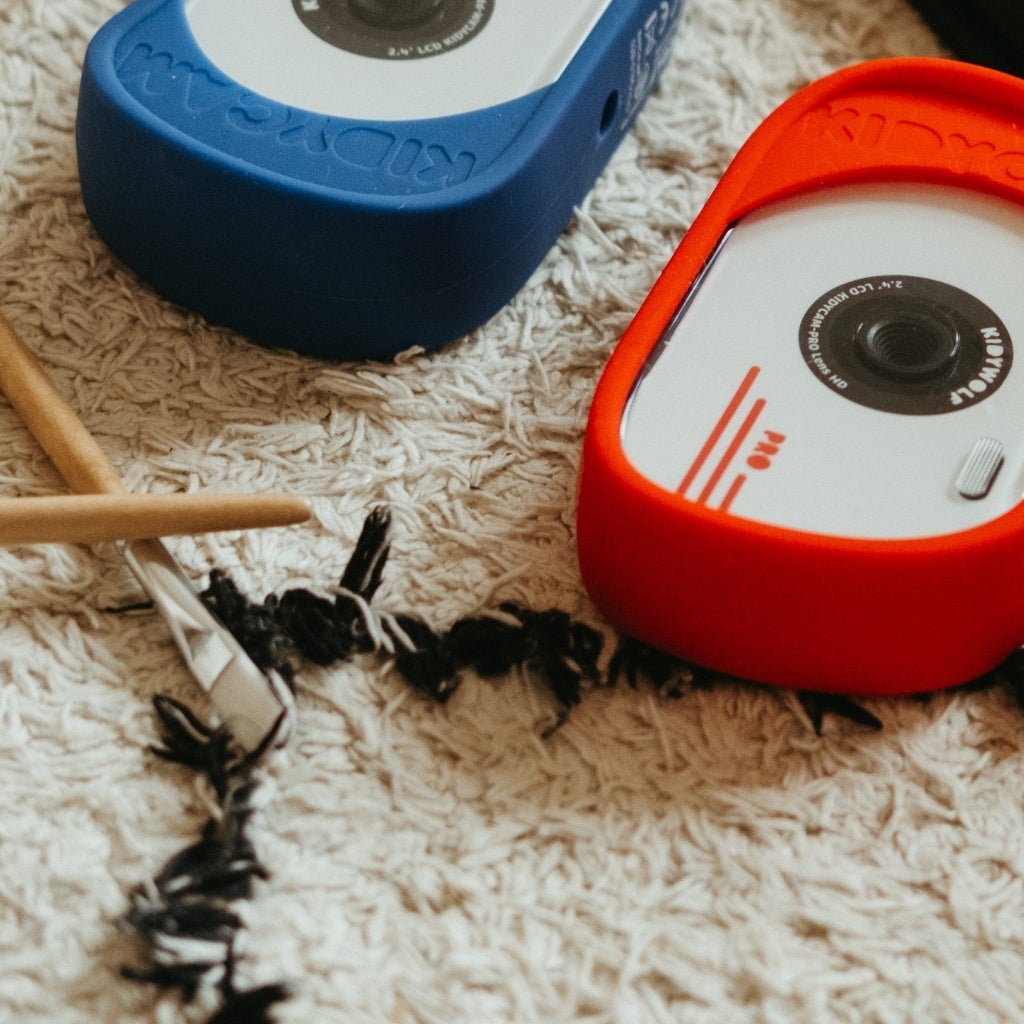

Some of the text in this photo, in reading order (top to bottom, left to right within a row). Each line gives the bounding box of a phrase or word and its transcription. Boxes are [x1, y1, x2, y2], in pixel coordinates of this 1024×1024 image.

[417, 42, 442, 55] LCD
[849, 282, 875, 296] LCD
[807, 291, 850, 350] KIDYCAM-PRO
[811, 351, 831, 376] Lens
[949, 325, 1004, 406] KIDYWOLF
[828, 375, 849, 390] HD
[746, 429, 787, 470] PRO
